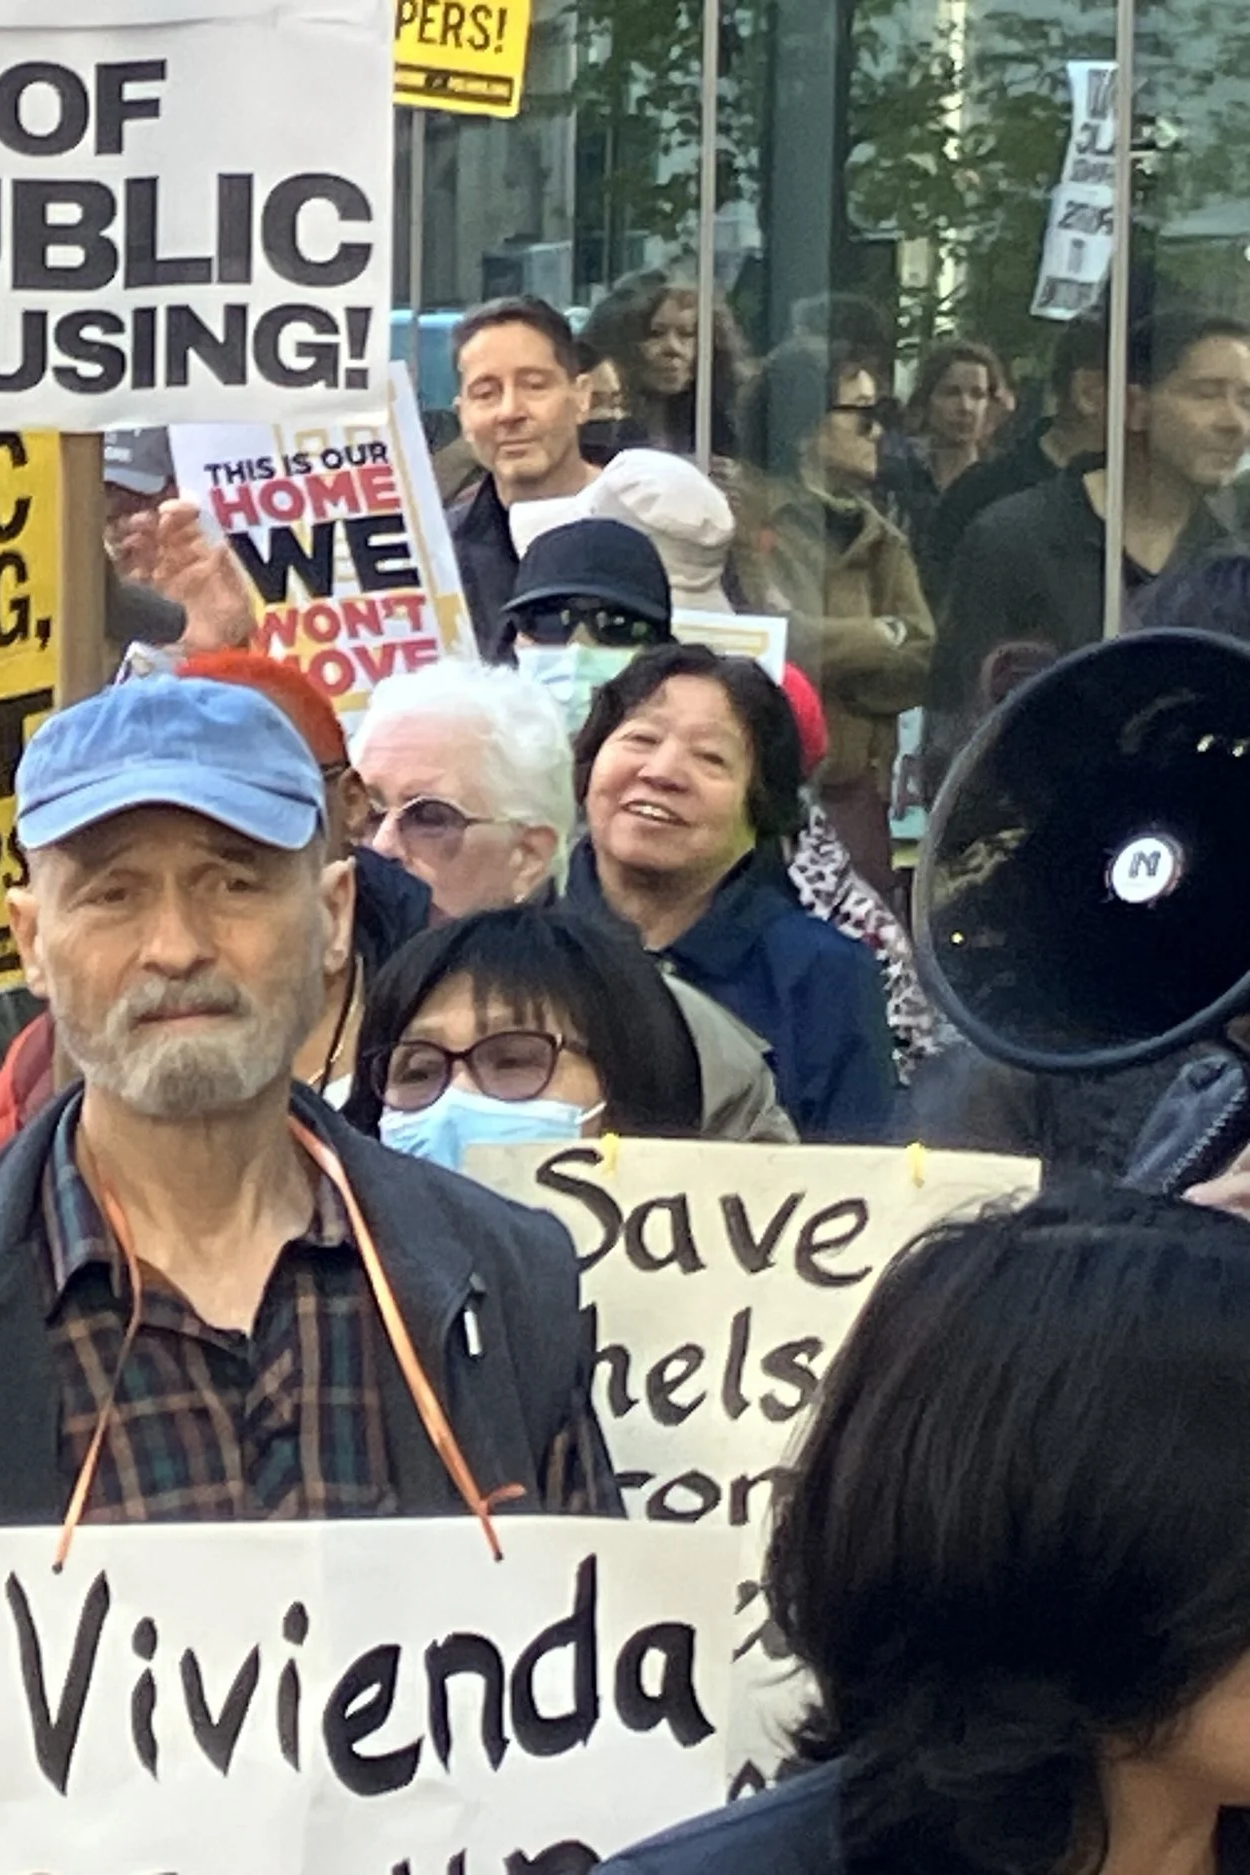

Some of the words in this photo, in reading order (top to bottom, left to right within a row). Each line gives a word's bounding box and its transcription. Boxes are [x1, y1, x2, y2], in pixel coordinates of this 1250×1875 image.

[204, 456, 276, 486] THIS
[283, 452, 313, 478] IS
[321, 440, 389, 469] OUR
[210, 465, 402, 529] HOME
[226, 513, 423, 605] WE
[283, 638, 439, 697] OVE
[535, 1146, 873, 1287] Save
[4, 1552, 715, 1797] Vivienda
